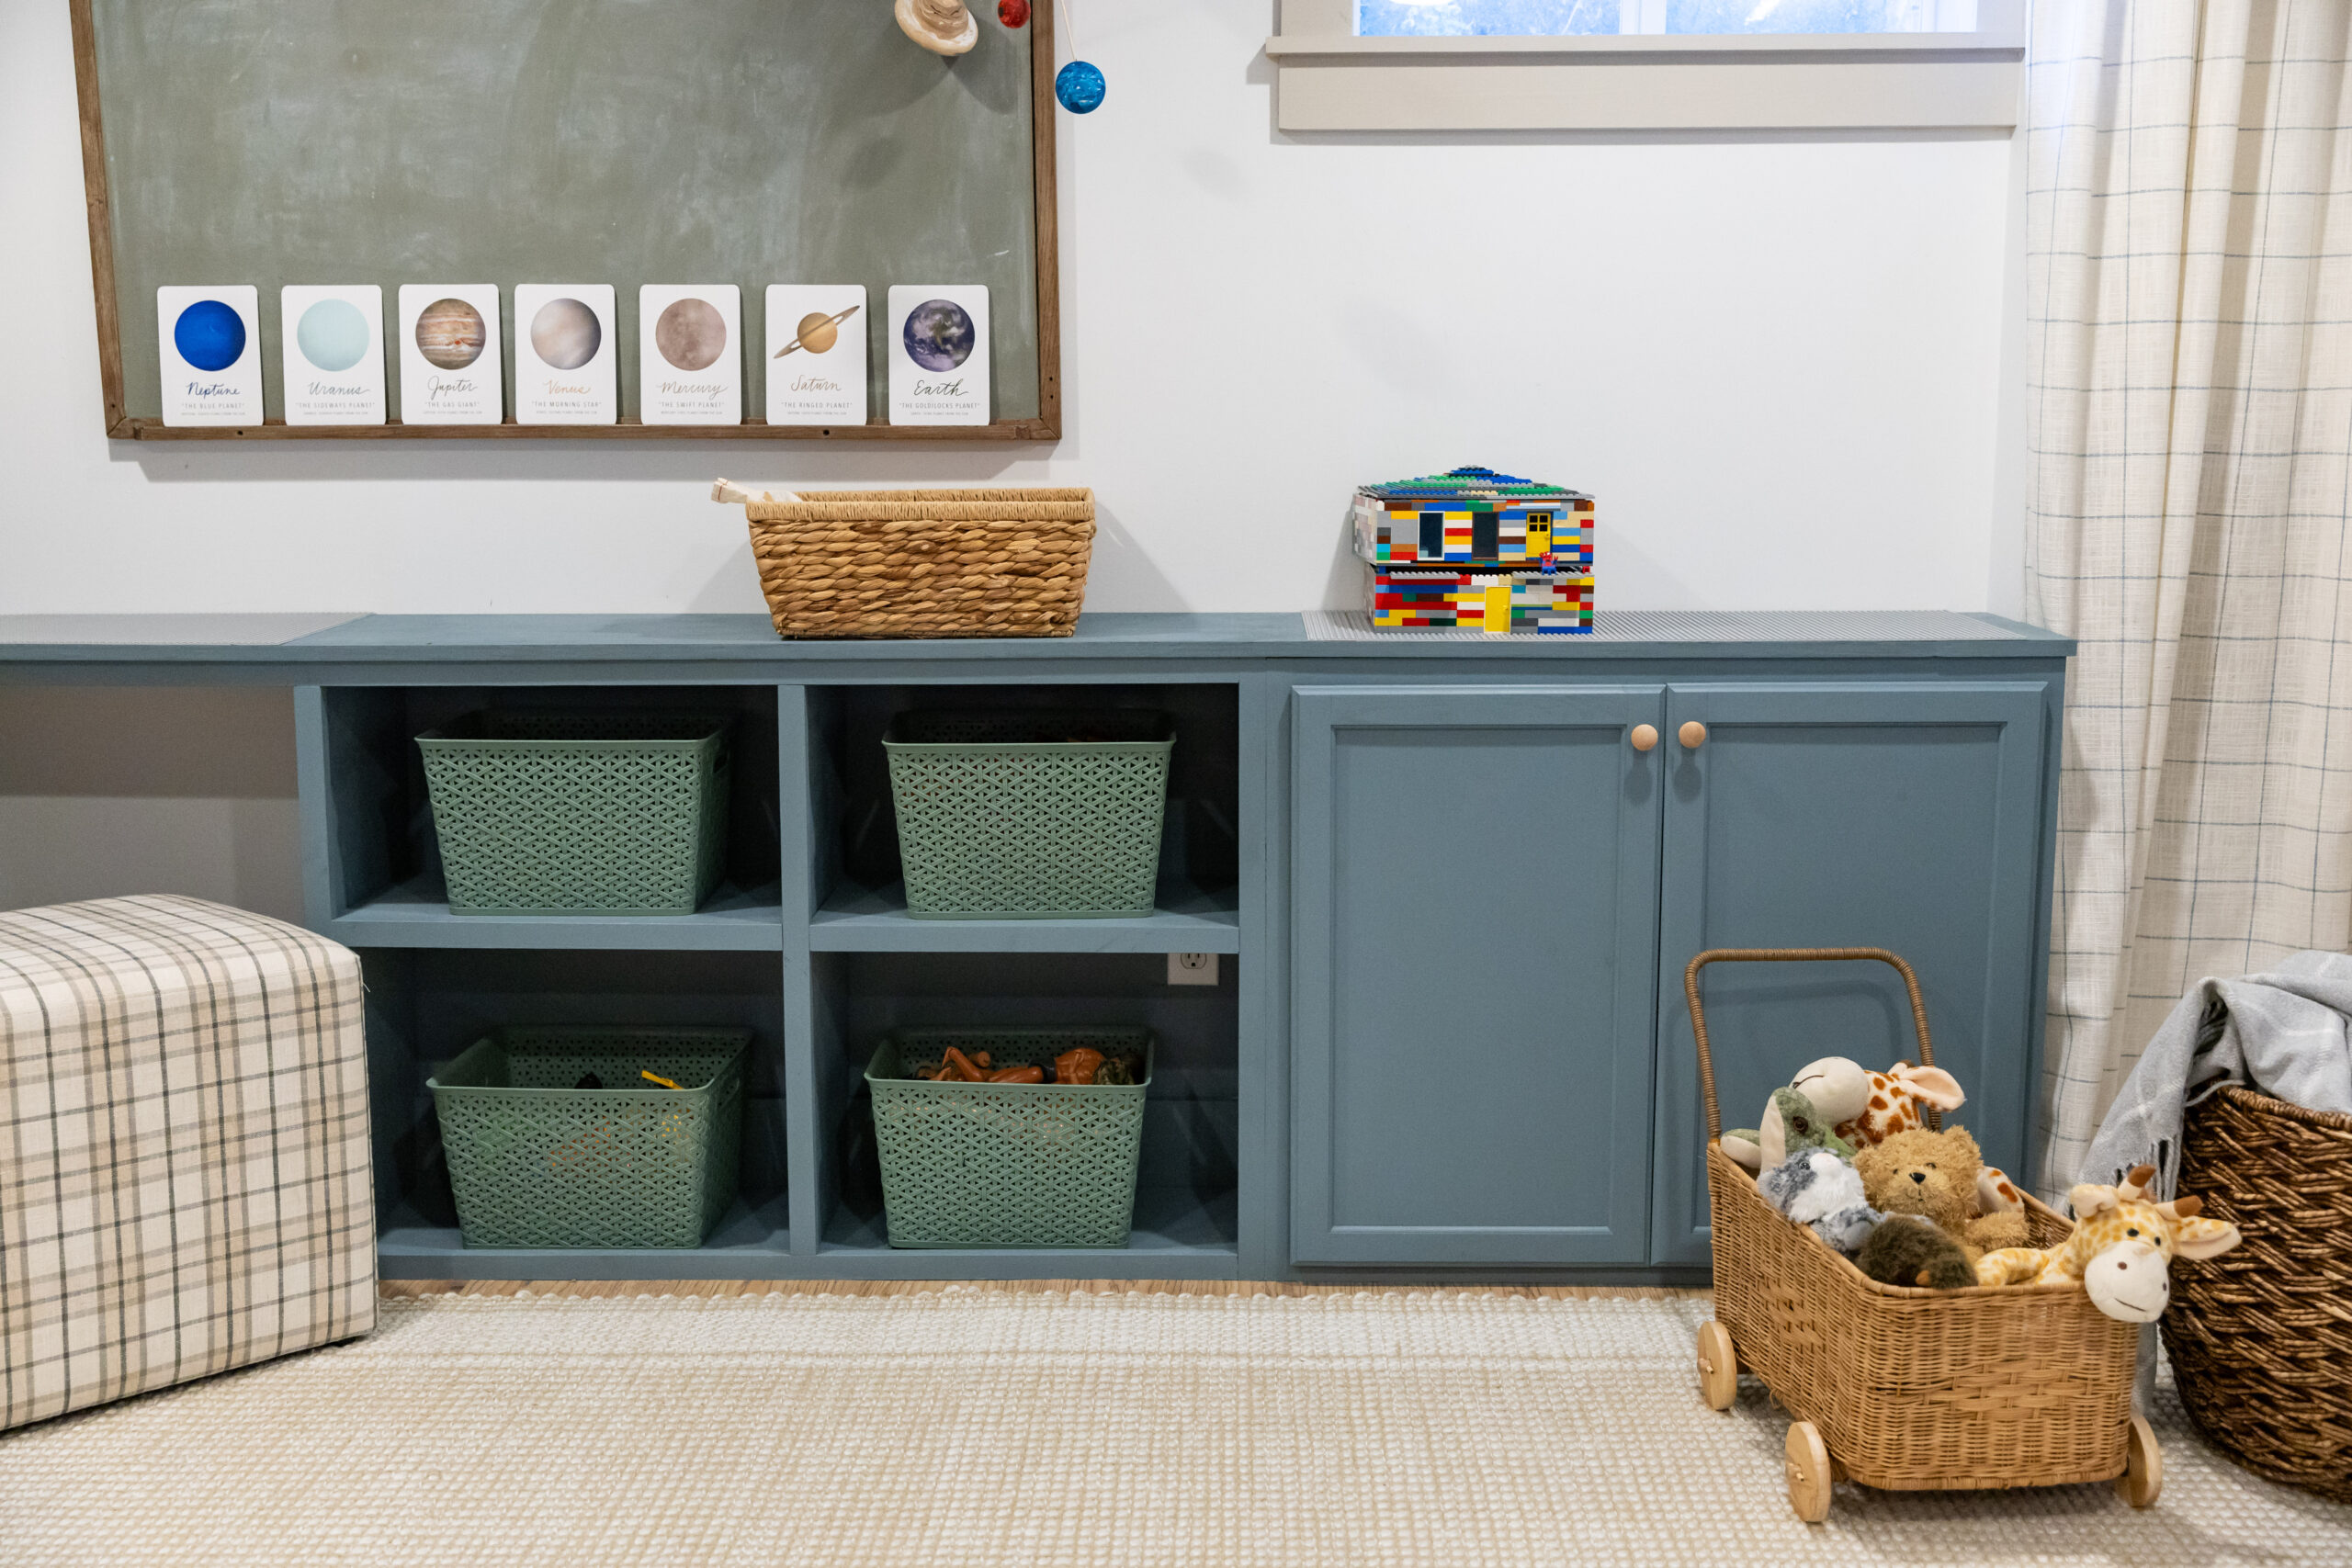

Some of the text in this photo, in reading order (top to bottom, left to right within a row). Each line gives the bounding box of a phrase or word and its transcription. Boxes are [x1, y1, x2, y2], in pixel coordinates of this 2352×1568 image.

[186, 381, 241, 400] Neptune
[308, 381, 370, 396] Uranus
[427, 375, 479, 400] Jupiter
[543, 379, 592, 395] Venus
[656, 380, 728, 400] Mercury
[790, 374, 842, 392] Saturn
[913, 378, 969, 397] Earth
